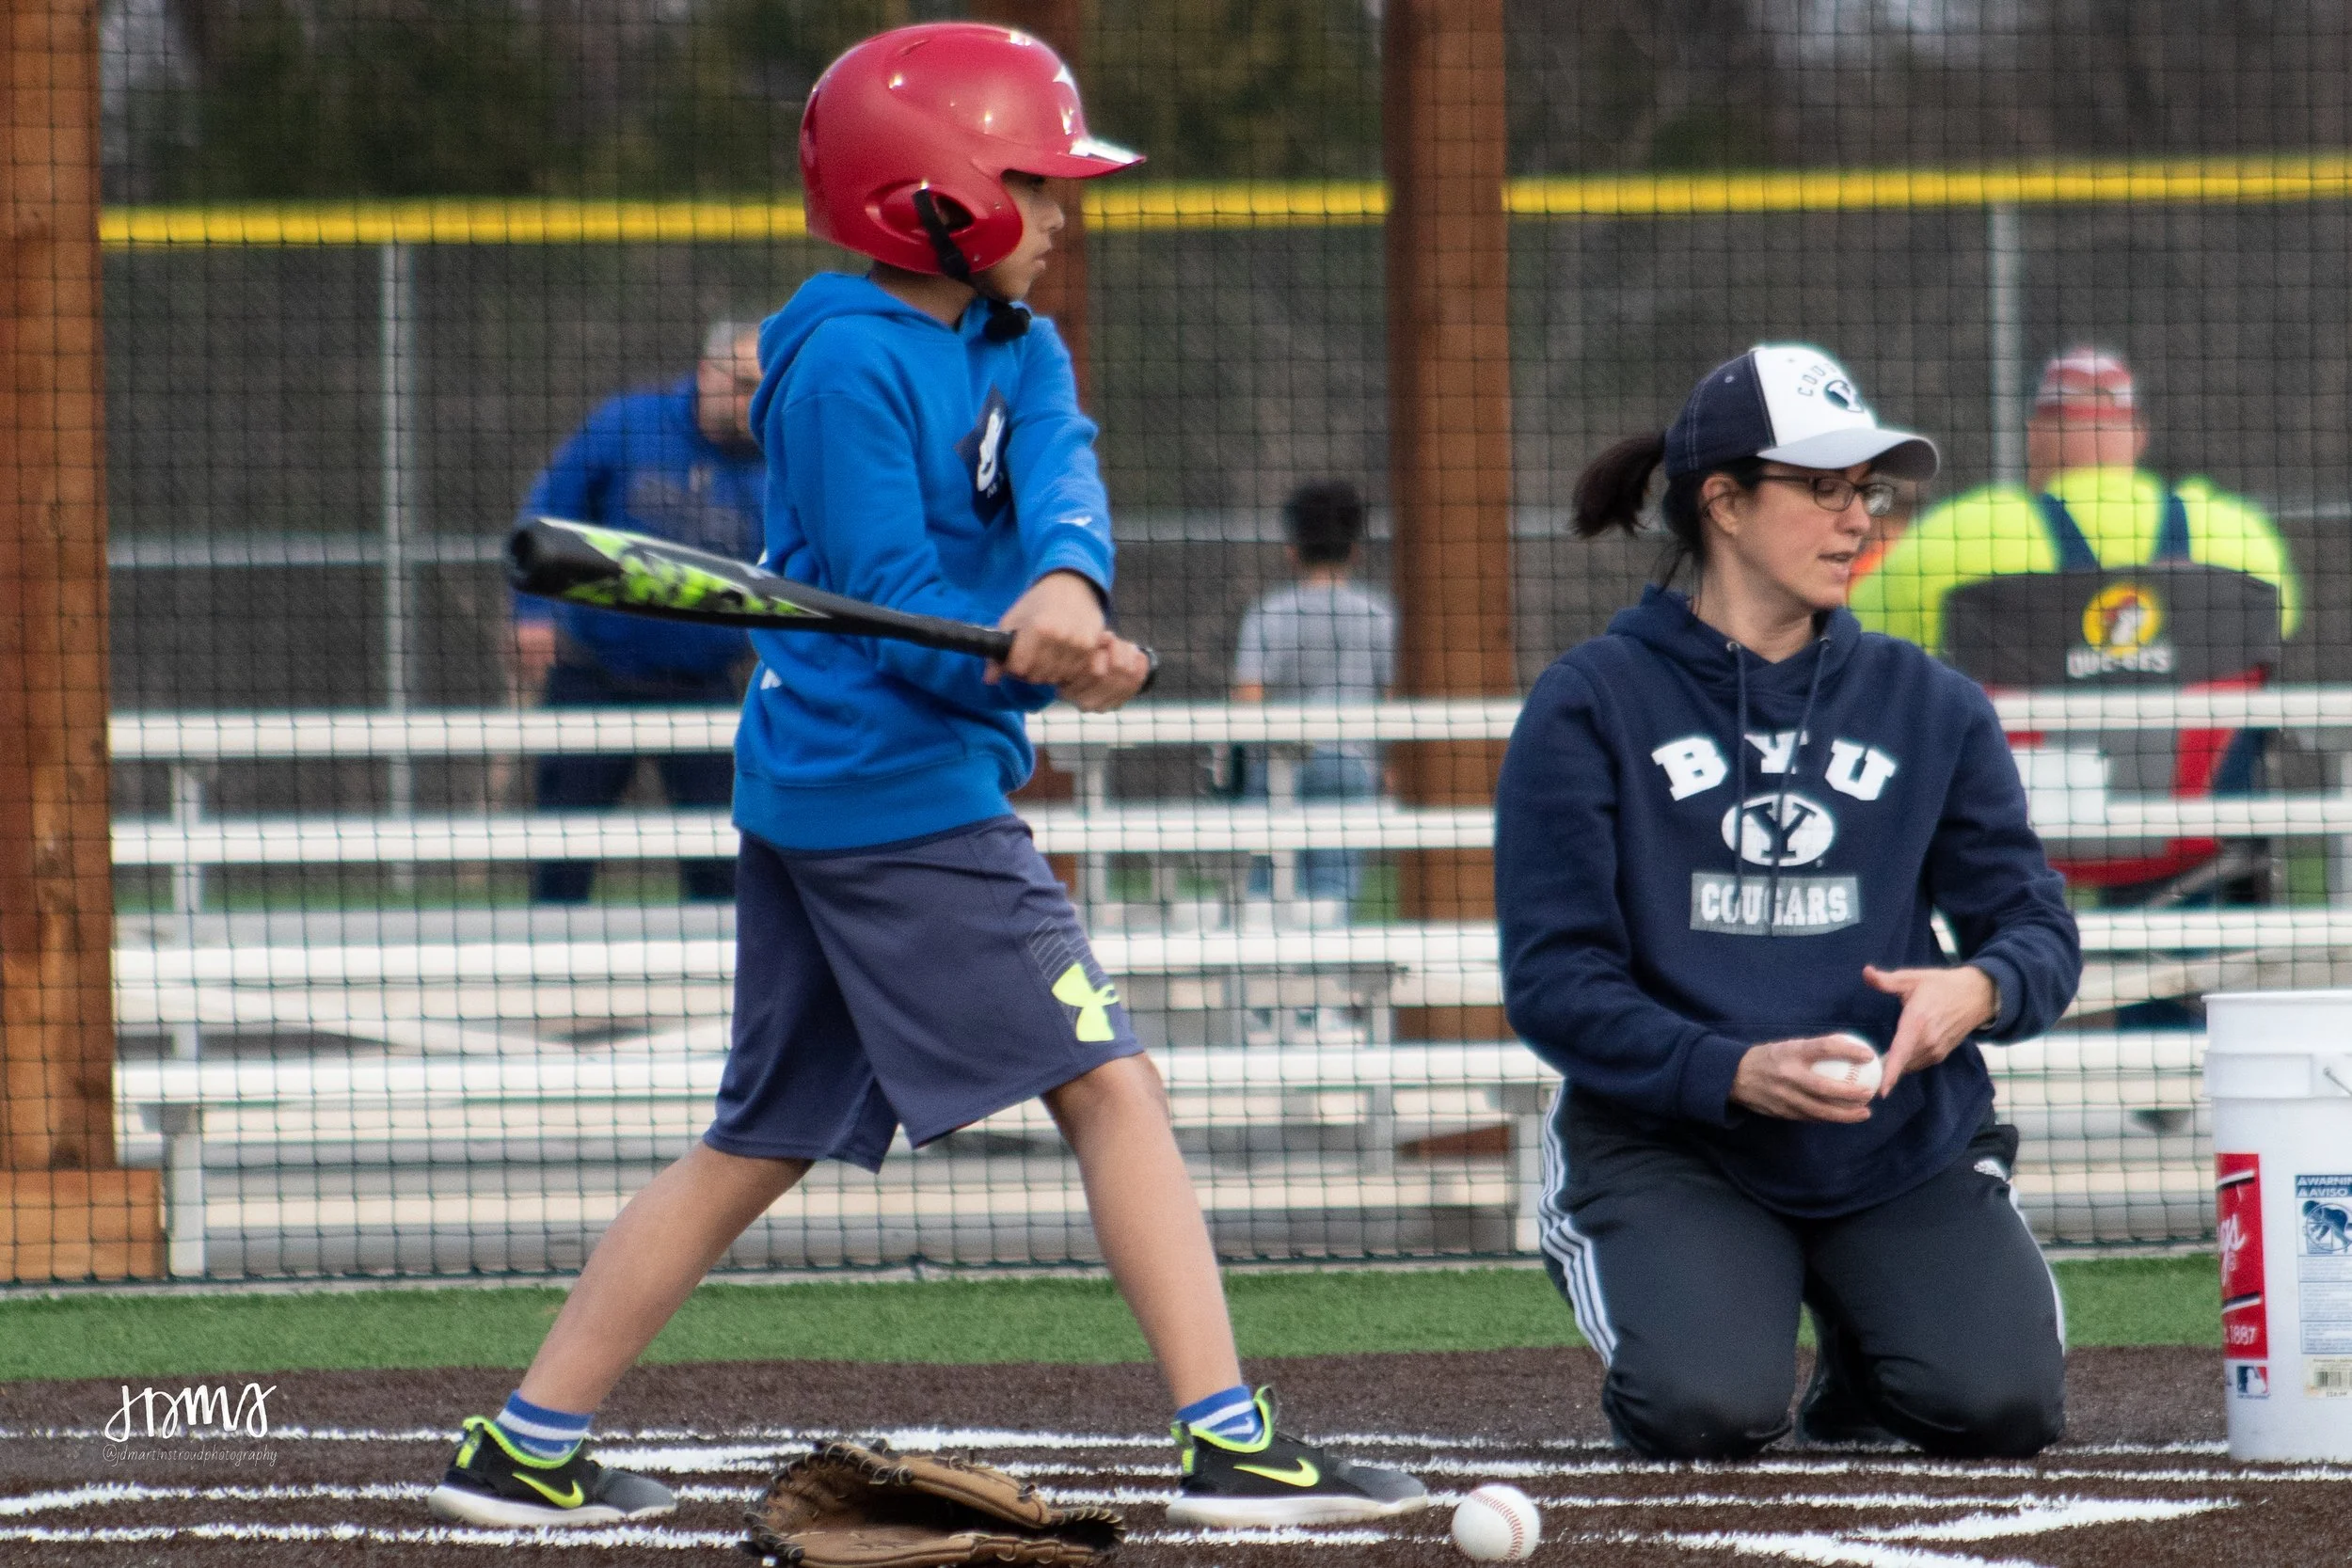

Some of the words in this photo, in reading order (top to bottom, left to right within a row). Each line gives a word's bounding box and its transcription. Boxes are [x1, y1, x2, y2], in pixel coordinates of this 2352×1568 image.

[1650, 730, 1897, 801] BYU
[1740, 800, 1818, 859] Y
[2309, 1188, 2349, 1197] AVISO
[2229, 1324, 2256, 1346] 1887
